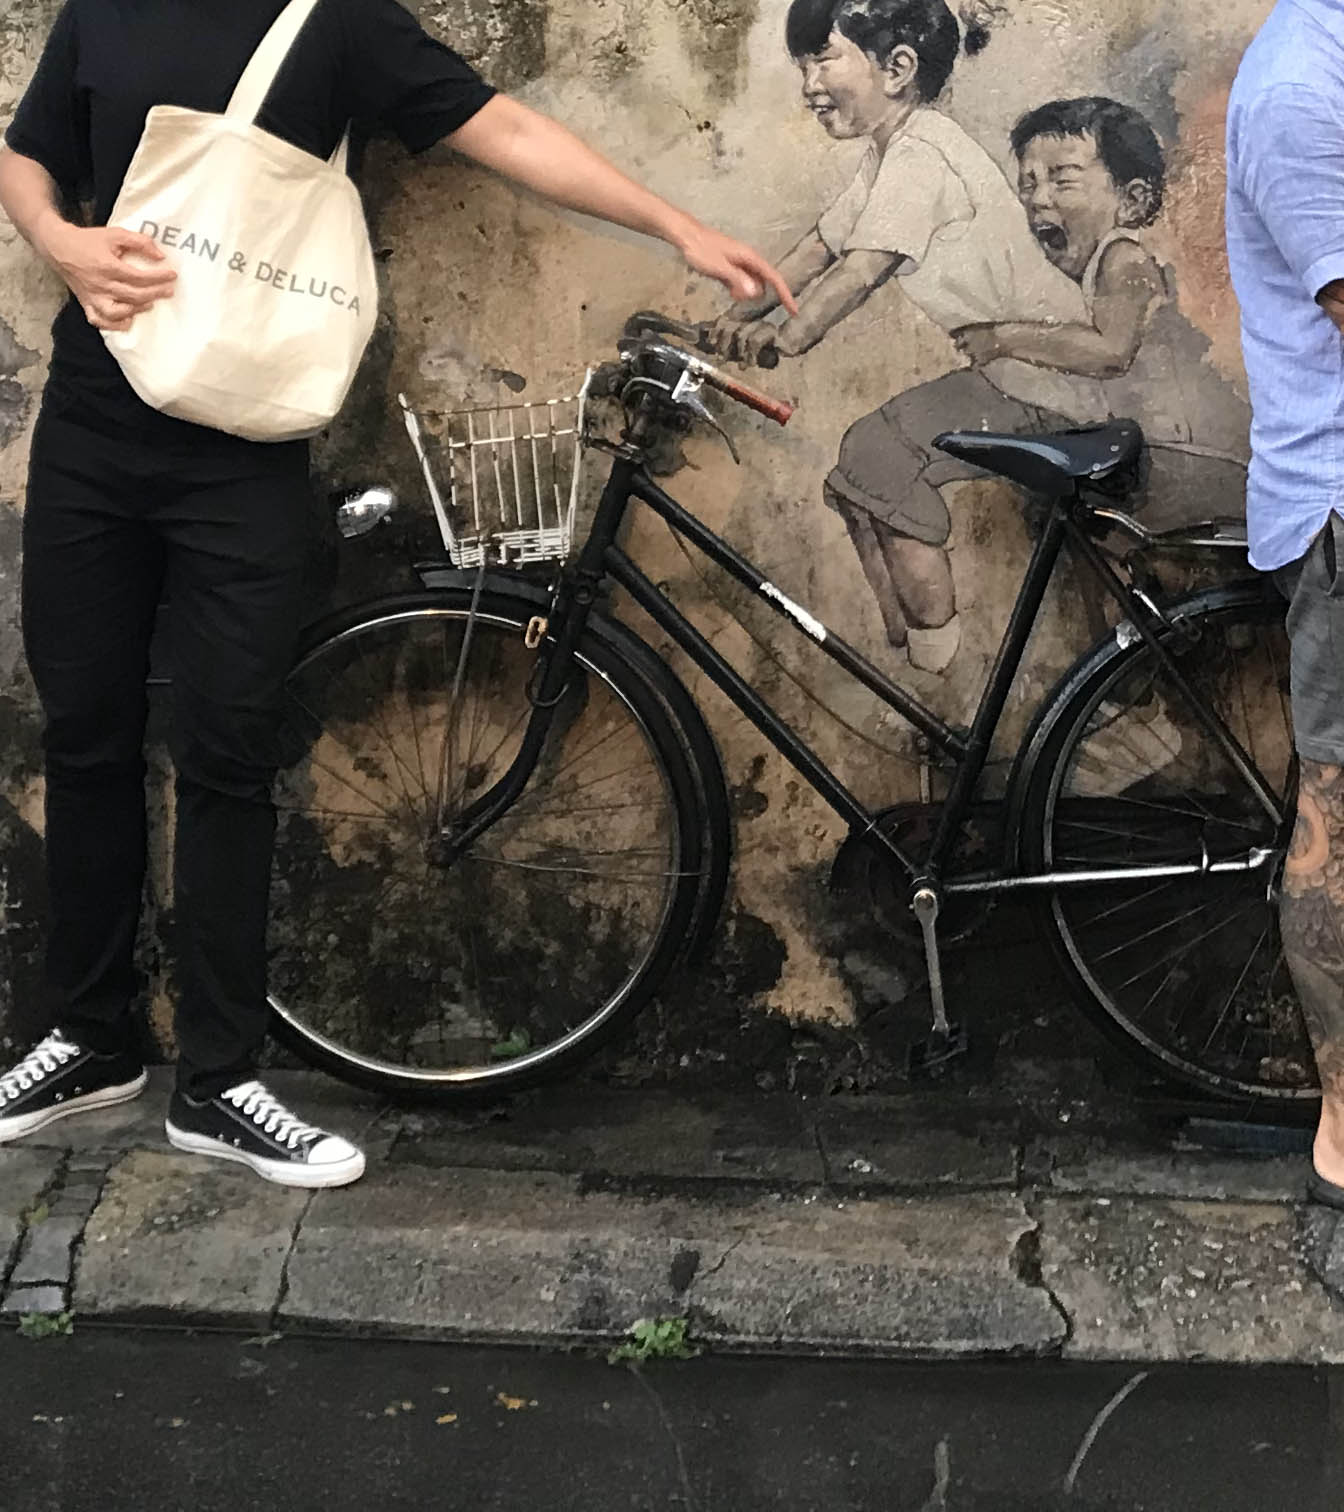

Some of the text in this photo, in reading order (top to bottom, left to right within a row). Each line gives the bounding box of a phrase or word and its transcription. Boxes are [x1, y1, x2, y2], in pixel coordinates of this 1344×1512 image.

[139, 220, 361, 317] DEAN & DELUCA
